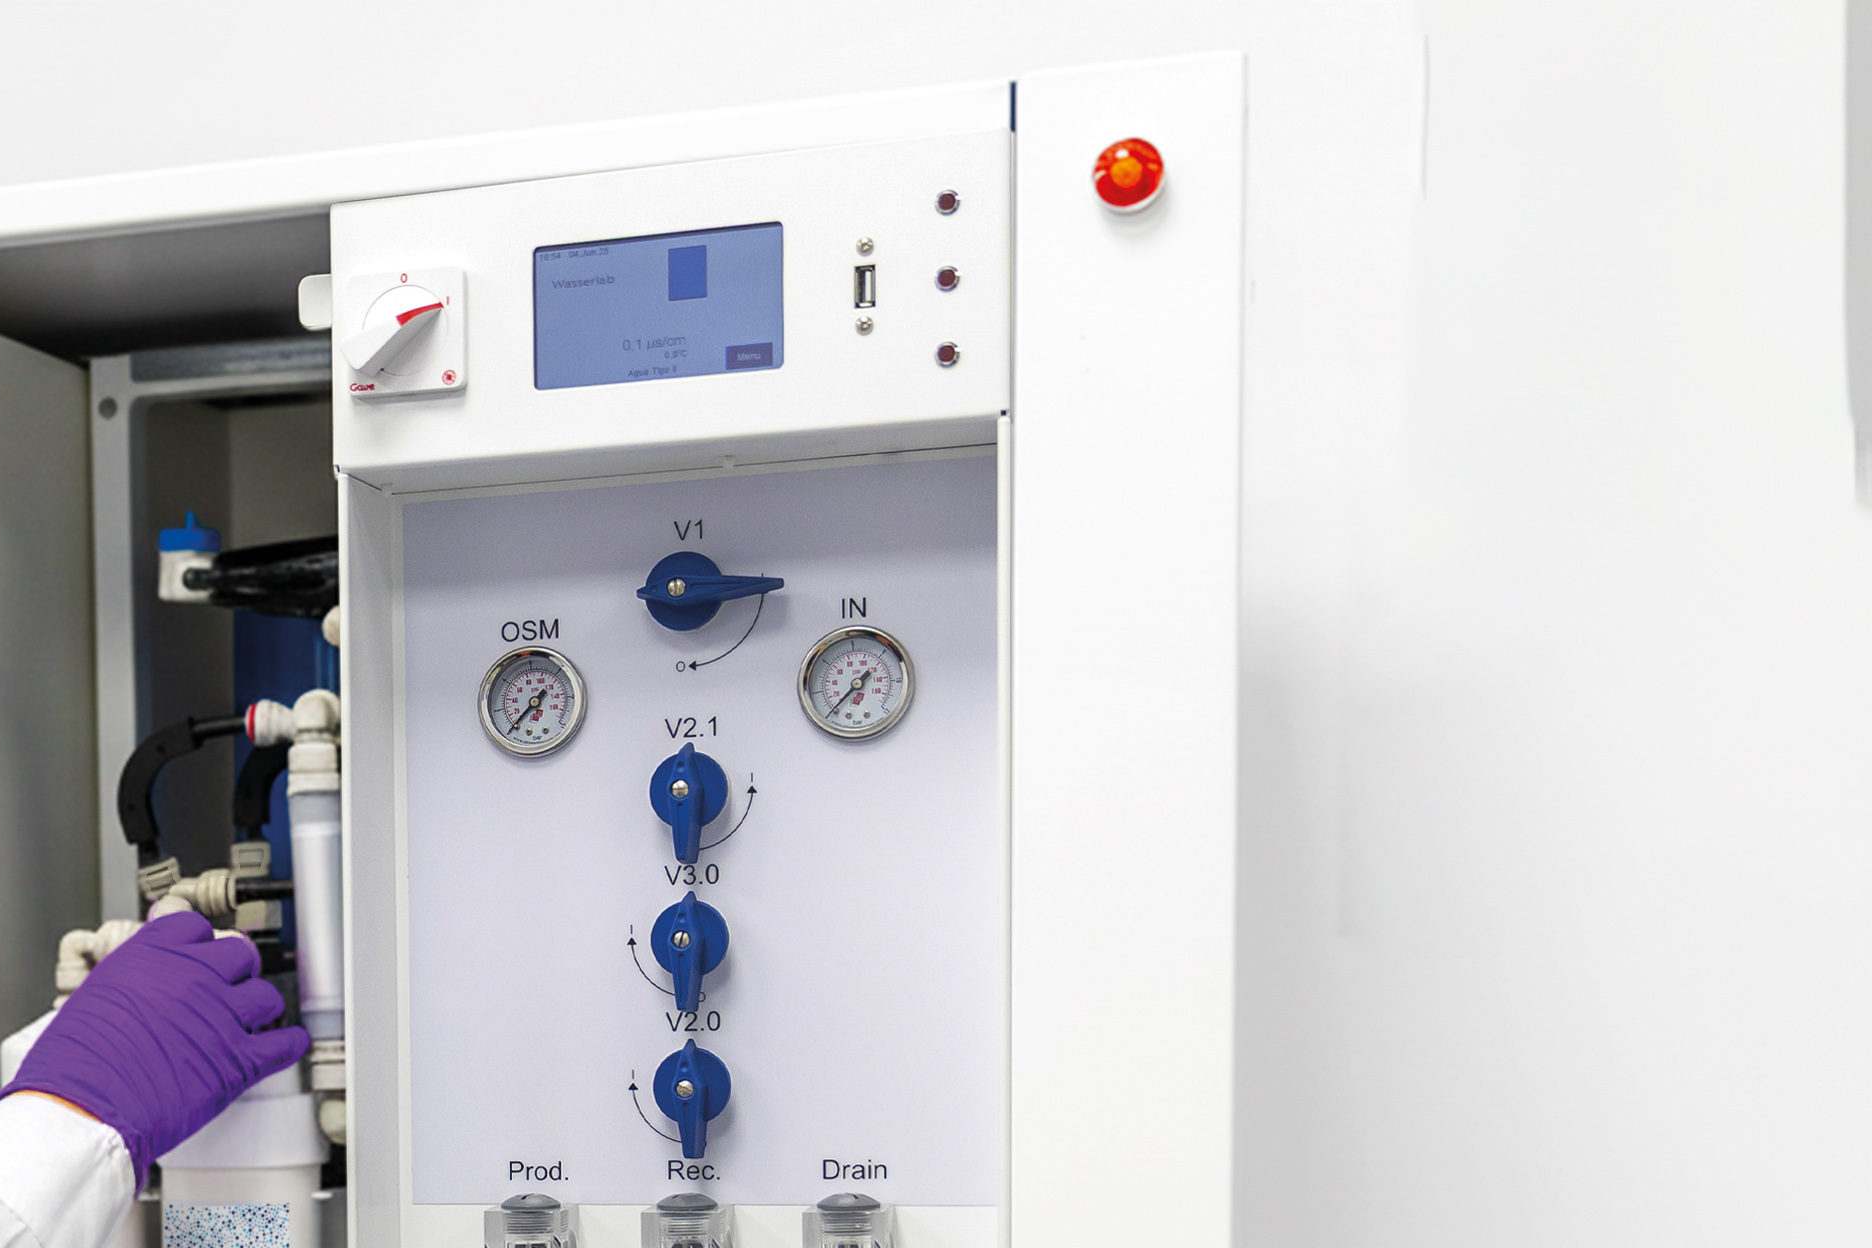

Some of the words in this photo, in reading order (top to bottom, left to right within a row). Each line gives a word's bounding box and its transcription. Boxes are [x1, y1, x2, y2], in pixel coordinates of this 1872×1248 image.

[552, 275, 615, 289] Wasserlab
[737, 352, 761, 361] Menu
[673, 519, 705, 541] V1
[840, 597, 867, 619] IN
[500, 618, 560, 642] OSM
[664, 716, 718, 738] V2.1
[664, 864, 720, 886] V3.0
[666, 1011, 721, 1032] V2.0
[509, 1160, 570, 1181] Prod.
[668, 1160, 721, 1181] Rec.
[822, 1158, 888, 1180] Drain
